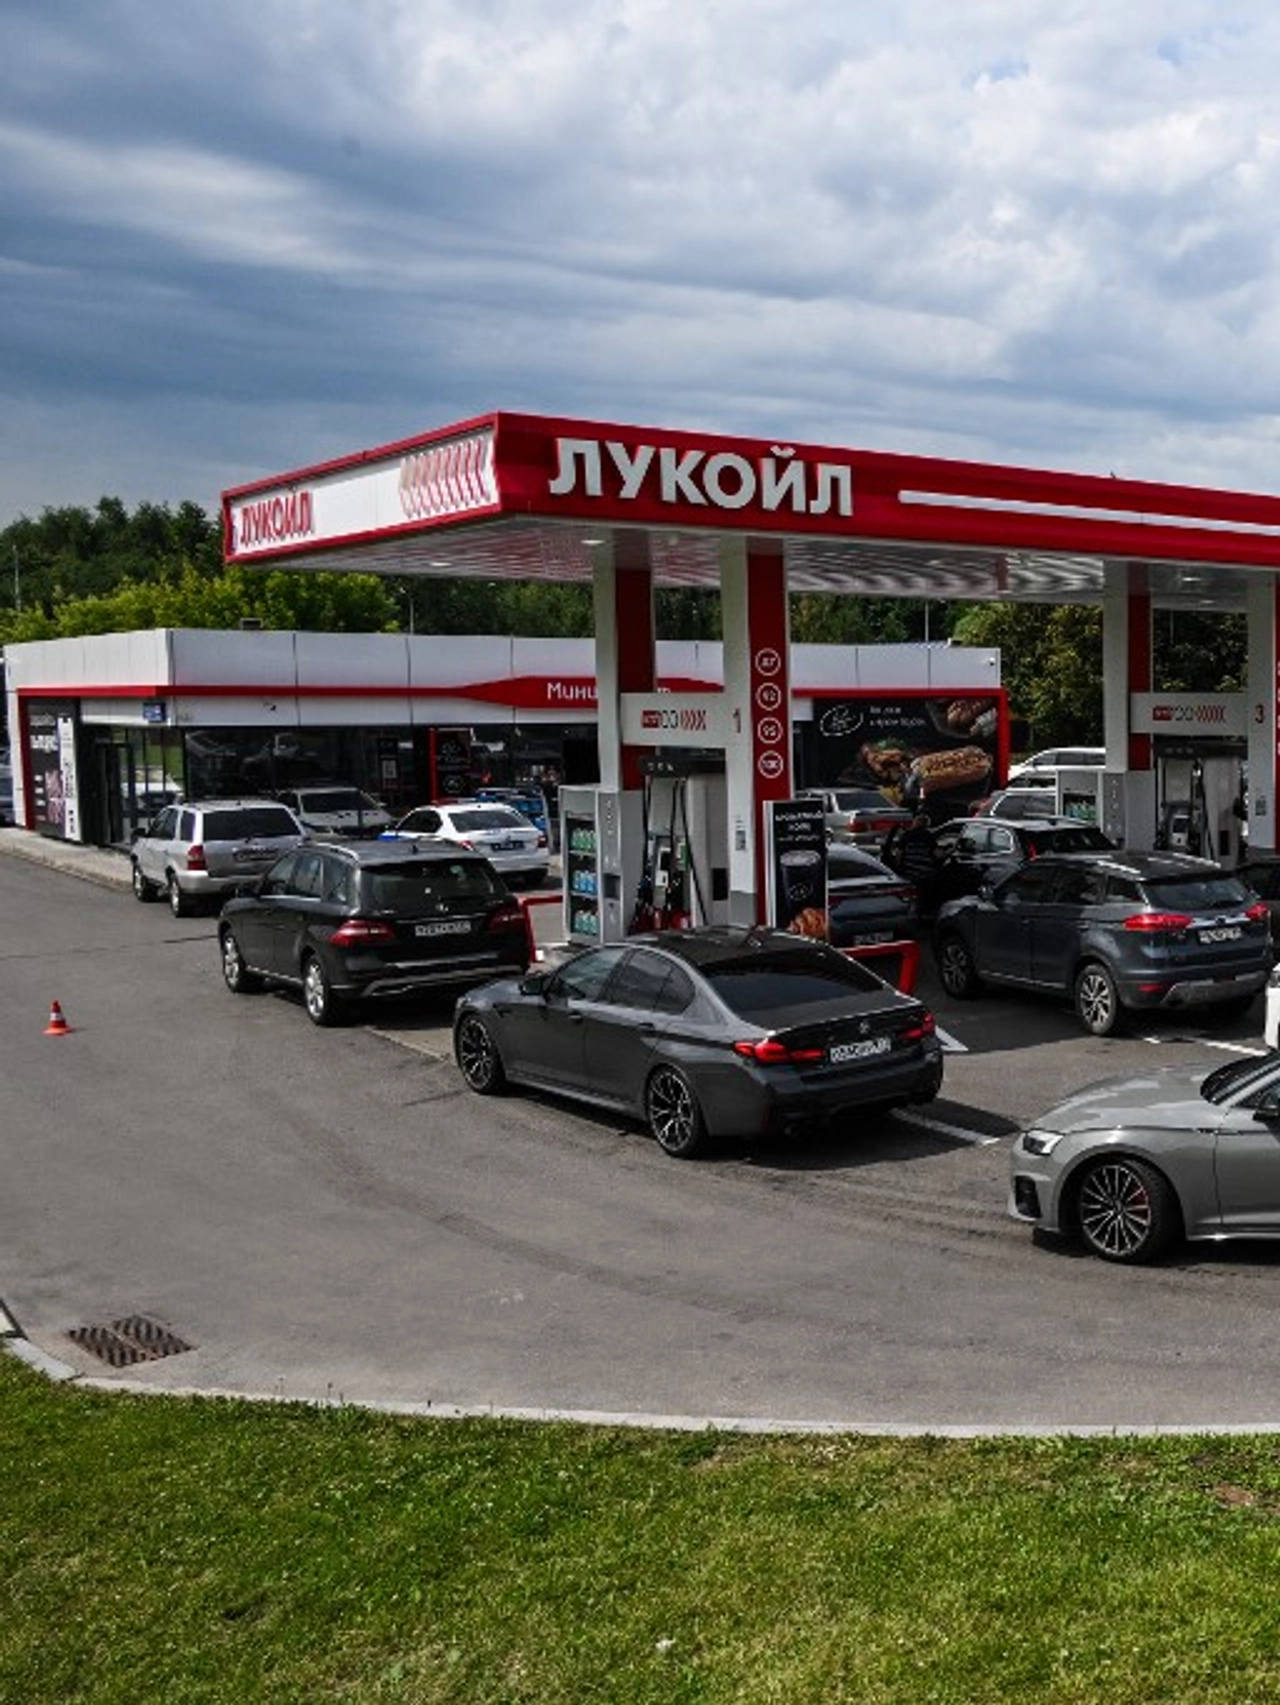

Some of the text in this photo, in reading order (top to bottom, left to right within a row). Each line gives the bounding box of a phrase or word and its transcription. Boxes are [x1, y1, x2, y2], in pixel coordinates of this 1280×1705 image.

[549, 437, 854, 517] ЛУКОЙЛ
[732, 708, 742, 734] 1
[1254, 704, 1265, 724] 3
